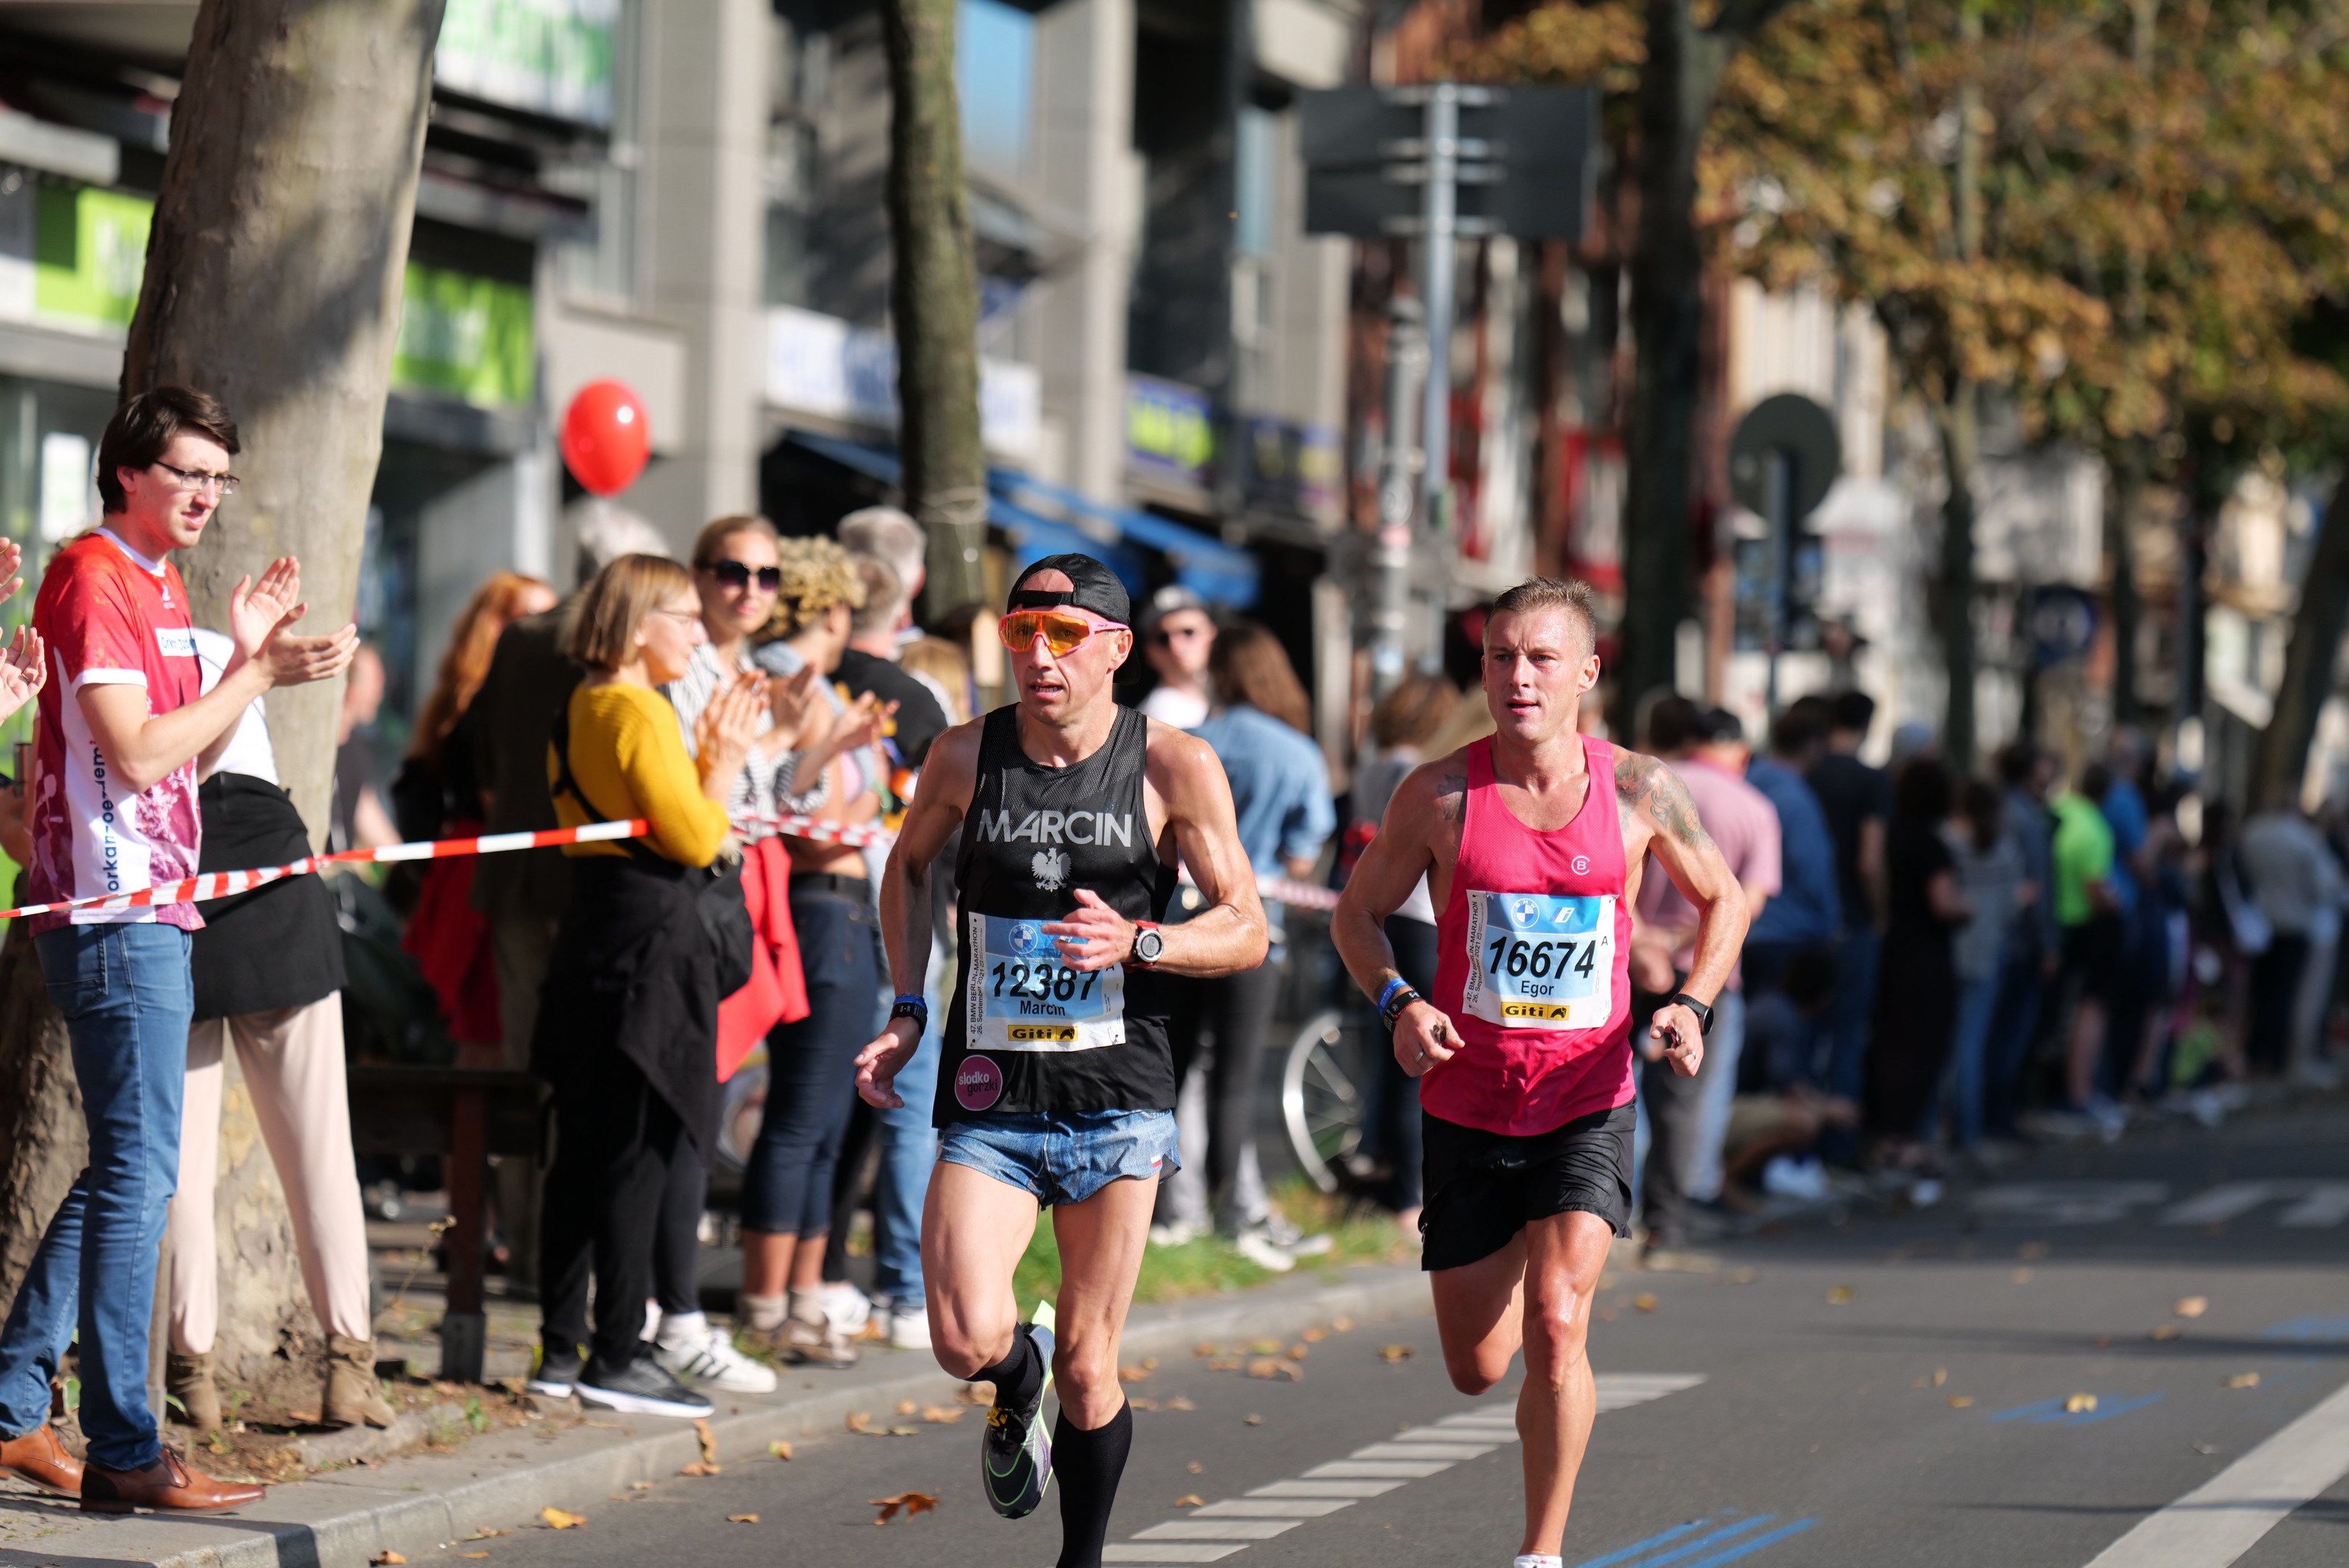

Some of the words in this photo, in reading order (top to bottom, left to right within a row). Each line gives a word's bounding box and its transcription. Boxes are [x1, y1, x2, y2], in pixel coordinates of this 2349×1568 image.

[976, 809, 1132, 848] MARCIN
[1515, 899, 1537, 909] BMW
[1469, 901, 1478, 971] BERLIN-MARATHON
[1601, 936, 1609, 947] A
[970, 926, 979, 1001] BERLIN-MARATHON
[1490, 936, 1596, 980] 16674
[992, 961, 1100, 1002] 12387
[1468, 971, 1477, 990] BMW
[1521, 980, 1555, 997] Egor
[1505, 1005, 1544, 1017] Giti
[1012, 1028, 1052, 1039] Giti
